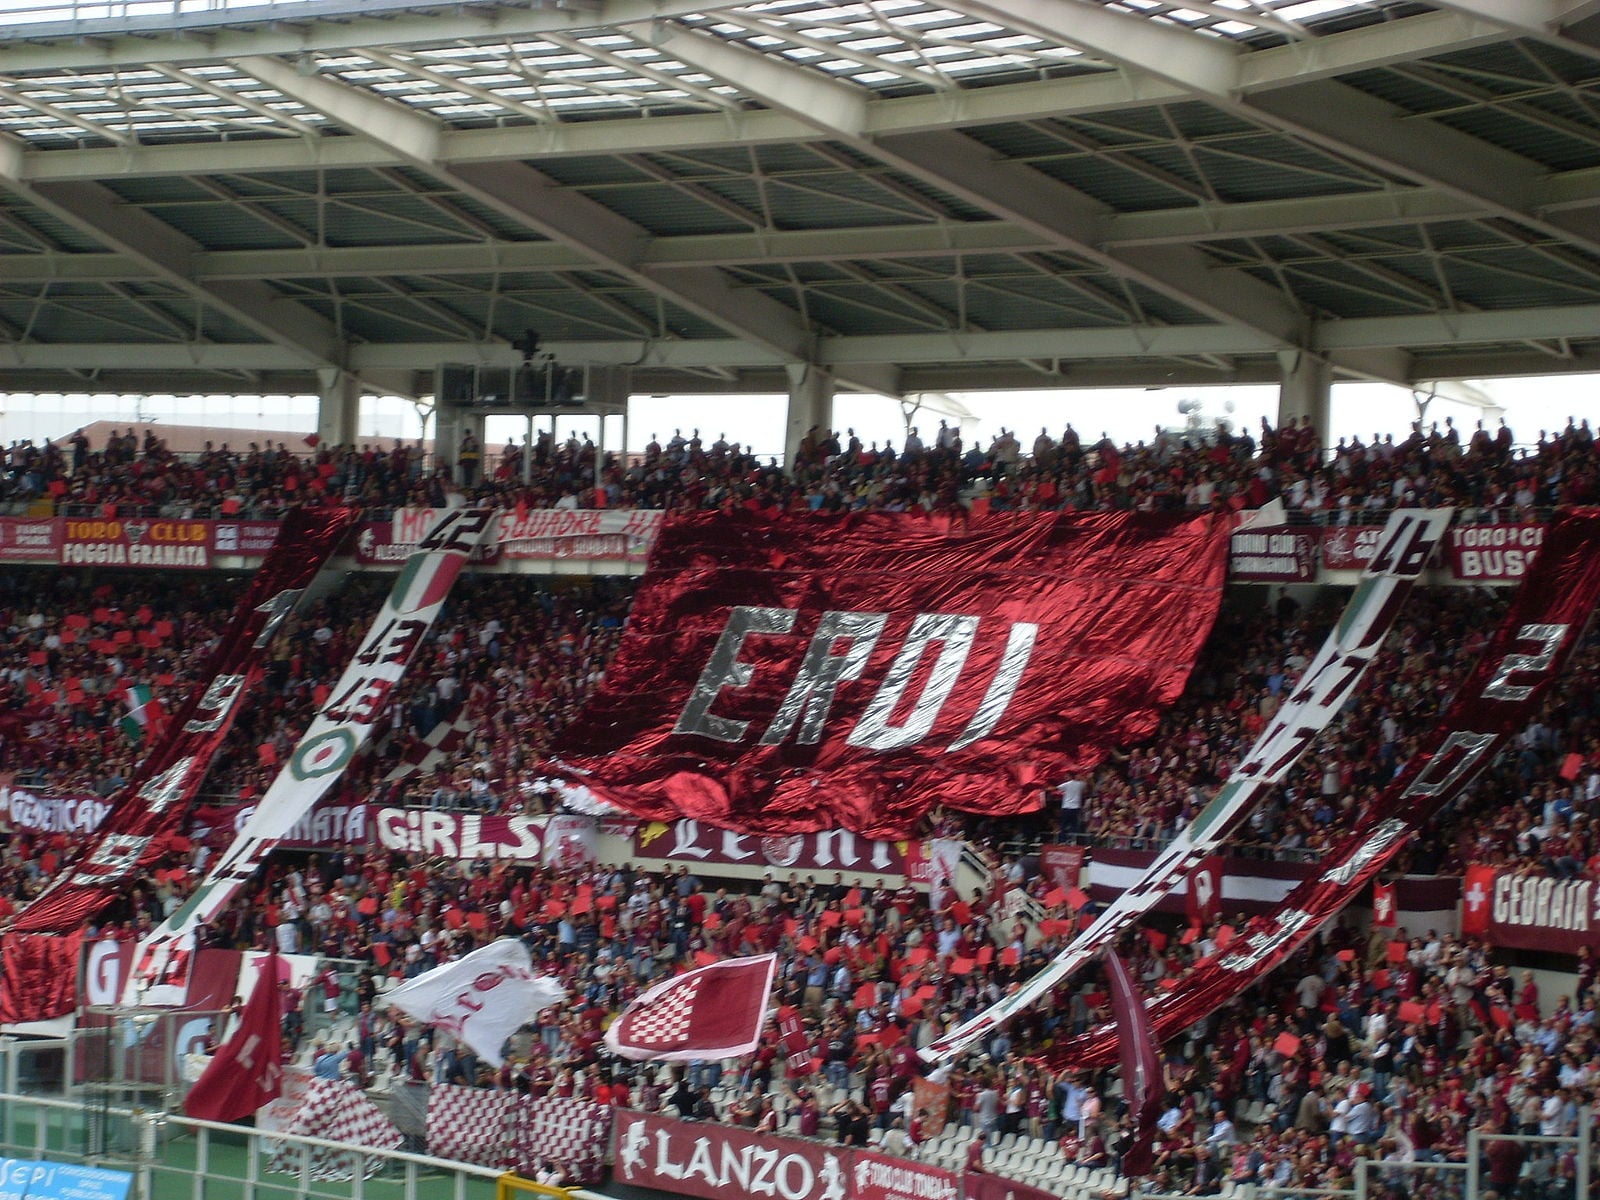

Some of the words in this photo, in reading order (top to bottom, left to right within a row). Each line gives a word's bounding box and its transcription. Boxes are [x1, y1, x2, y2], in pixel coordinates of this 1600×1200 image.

[65, 521, 121, 539] TORO
[150, 522, 207, 541] CLUB
[418, 510, 497, 552] 42
[1453, 527, 1507, 547] TORO
[63, 543, 126, 563] FOGGIA
[128, 544, 207, 566] GRANATA
[1461, 549, 1537, 576] BUS
[655, 1127, 815, 1199] LANZO
